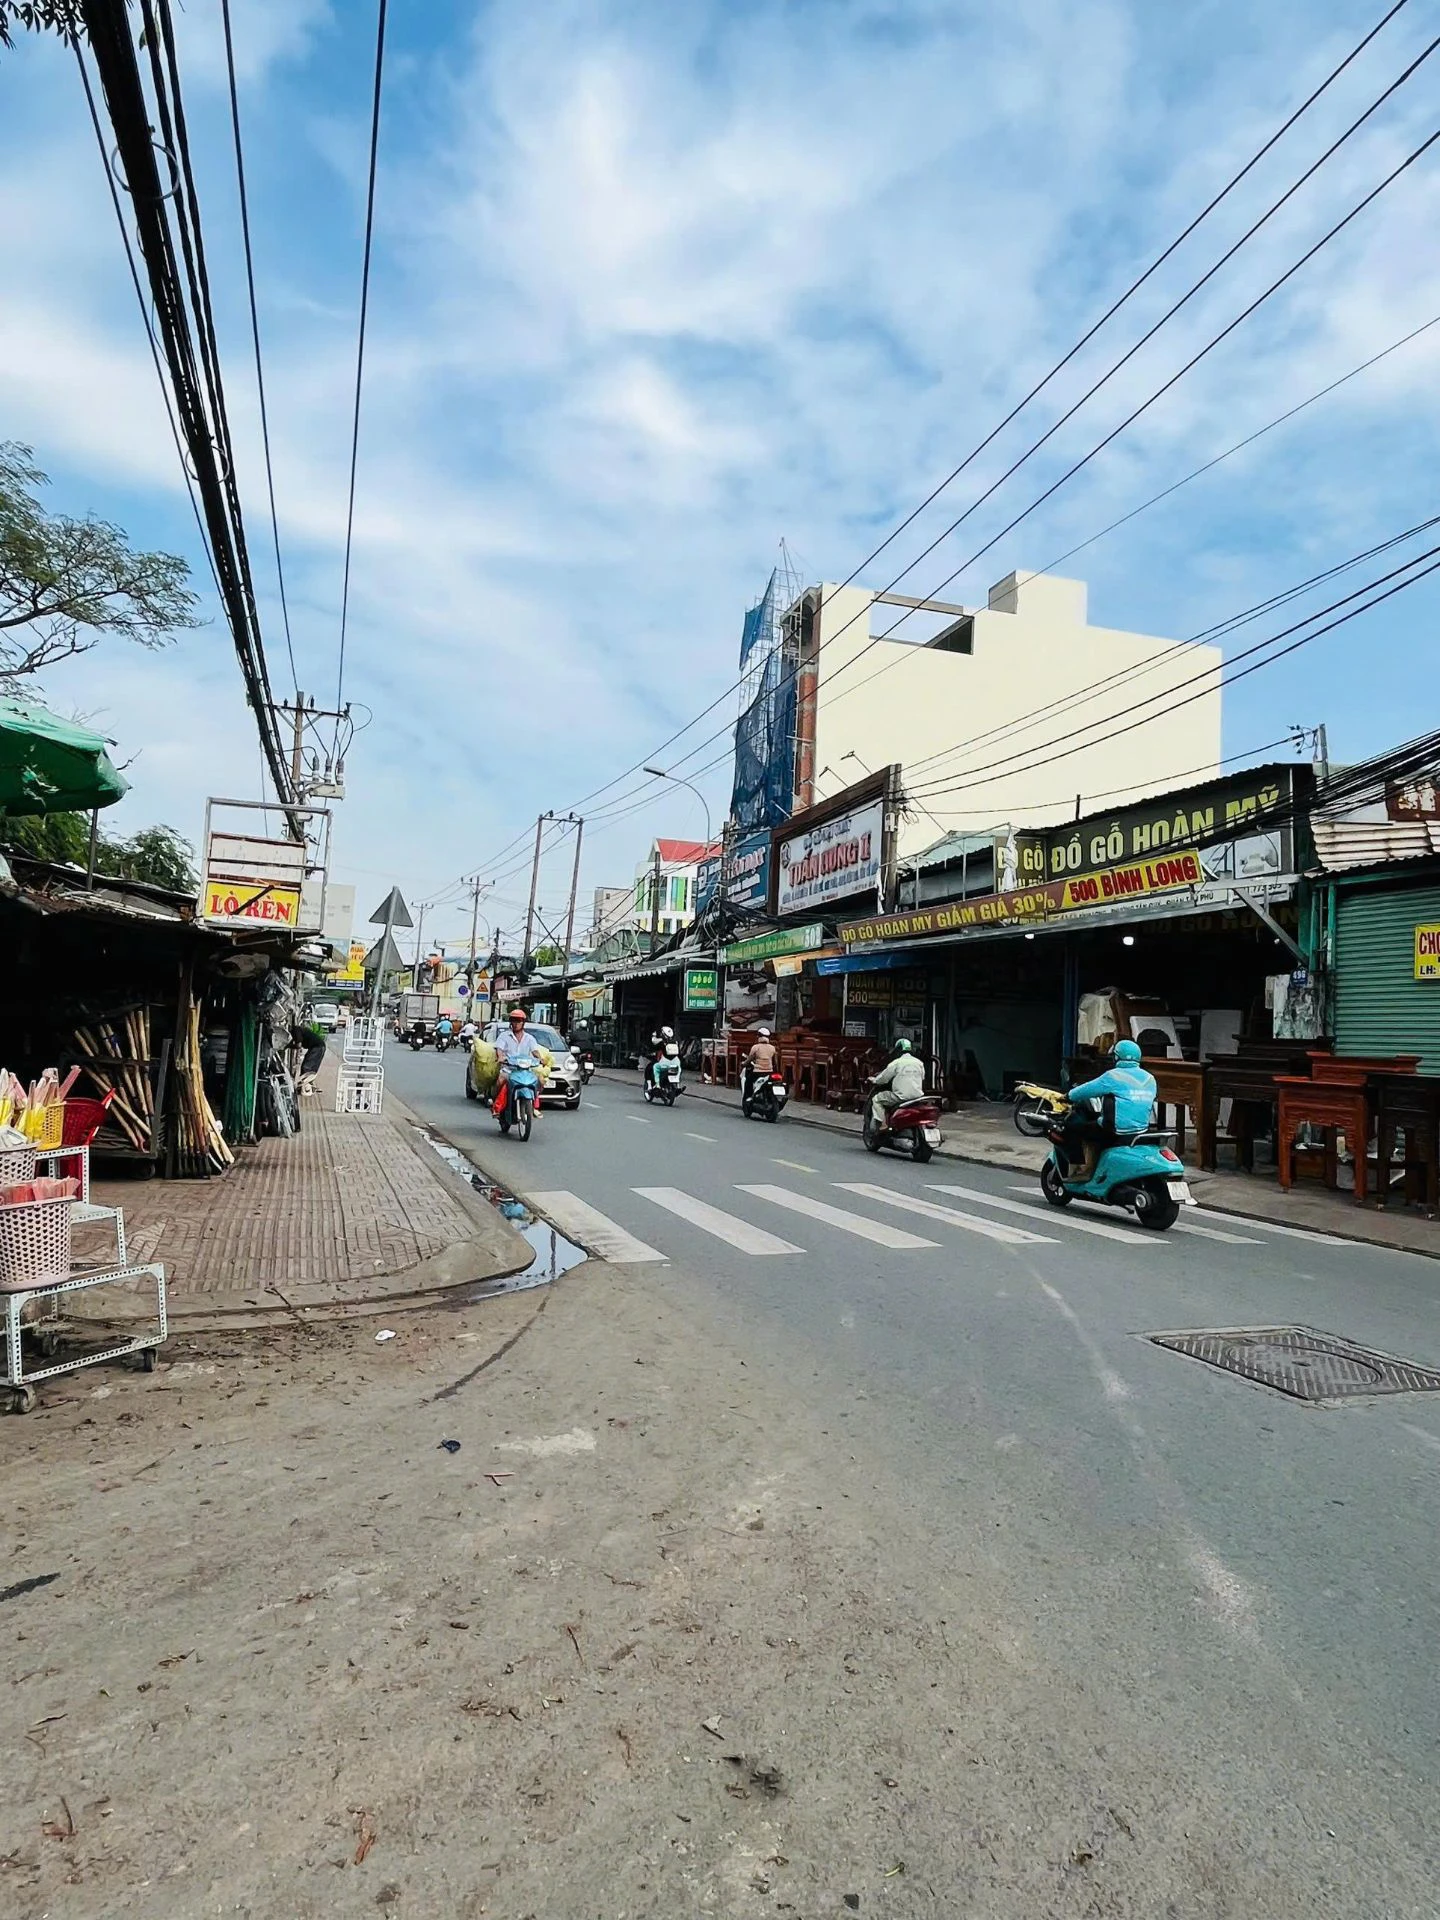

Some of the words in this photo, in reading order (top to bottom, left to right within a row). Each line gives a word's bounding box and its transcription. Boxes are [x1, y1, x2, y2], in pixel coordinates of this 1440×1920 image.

[1023, 841, 1044, 871] GỖ
[1051, 832, 1082, 874] ĐỒ
[1090, 821, 1124, 865] GỖ
[1132, 809, 1215, 855] HOÀN
[1068, 879, 1099, 903] 500
[1100, 867, 1144, 897] BÌNH
[1146, 856, 1198, 888] LONG
[210, 890, 239, 916] LÒ
[937, 904, 977, 929] GIẢM
[980, 897, 1009, 921] GIÁ
[1012, 891, 1056, 915] 30%
